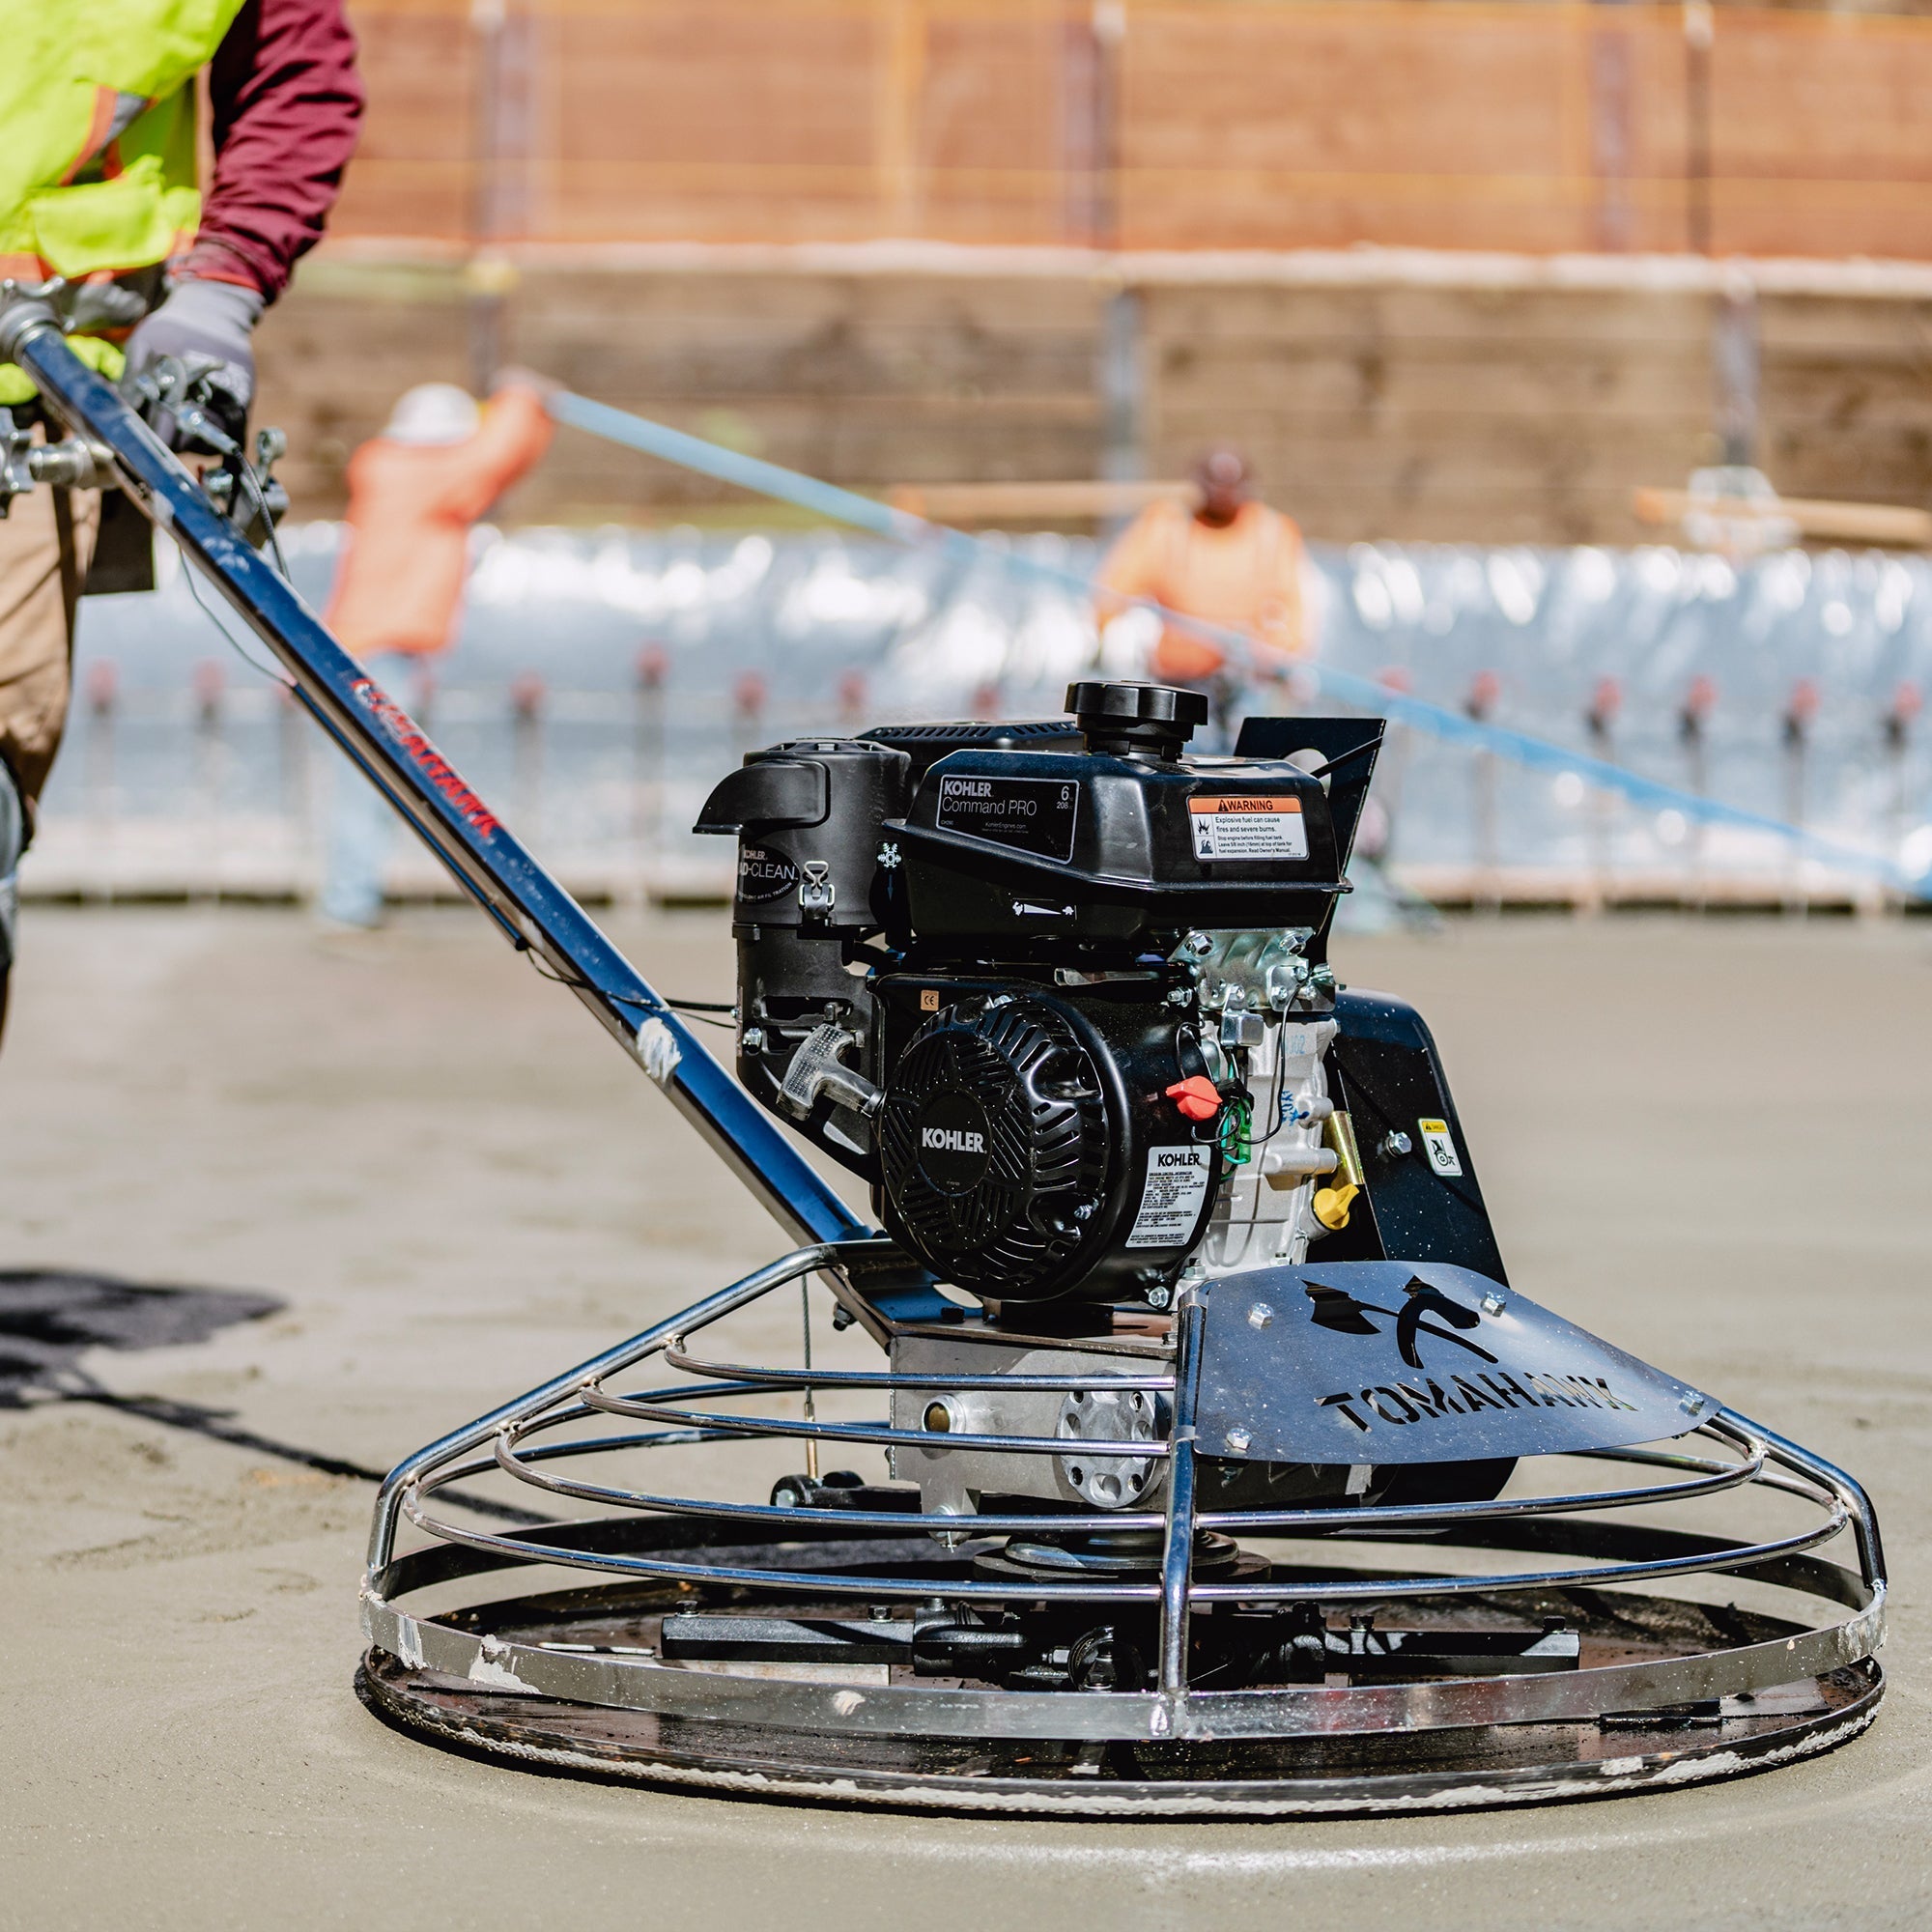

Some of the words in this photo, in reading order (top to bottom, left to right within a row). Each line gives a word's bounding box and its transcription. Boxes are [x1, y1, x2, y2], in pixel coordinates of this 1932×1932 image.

[944, 781, 992, 797] KOHLER
[1061, 785, 1069, 801] 6
[942, 797, 1006, 814] Command
[1009, 800, 1037, 816] PRO
[1056, 801, 1068, 810] 208
[1227, 800, 1273, 811] WARNING
[924, 996, 935, 1006] CE
[922, 1127, 984, 1152] KOHLER
[1158, 1152, 1200, 1167] KOHLER
[1314, 1373, 1638, 1433] TOMAHAWK
